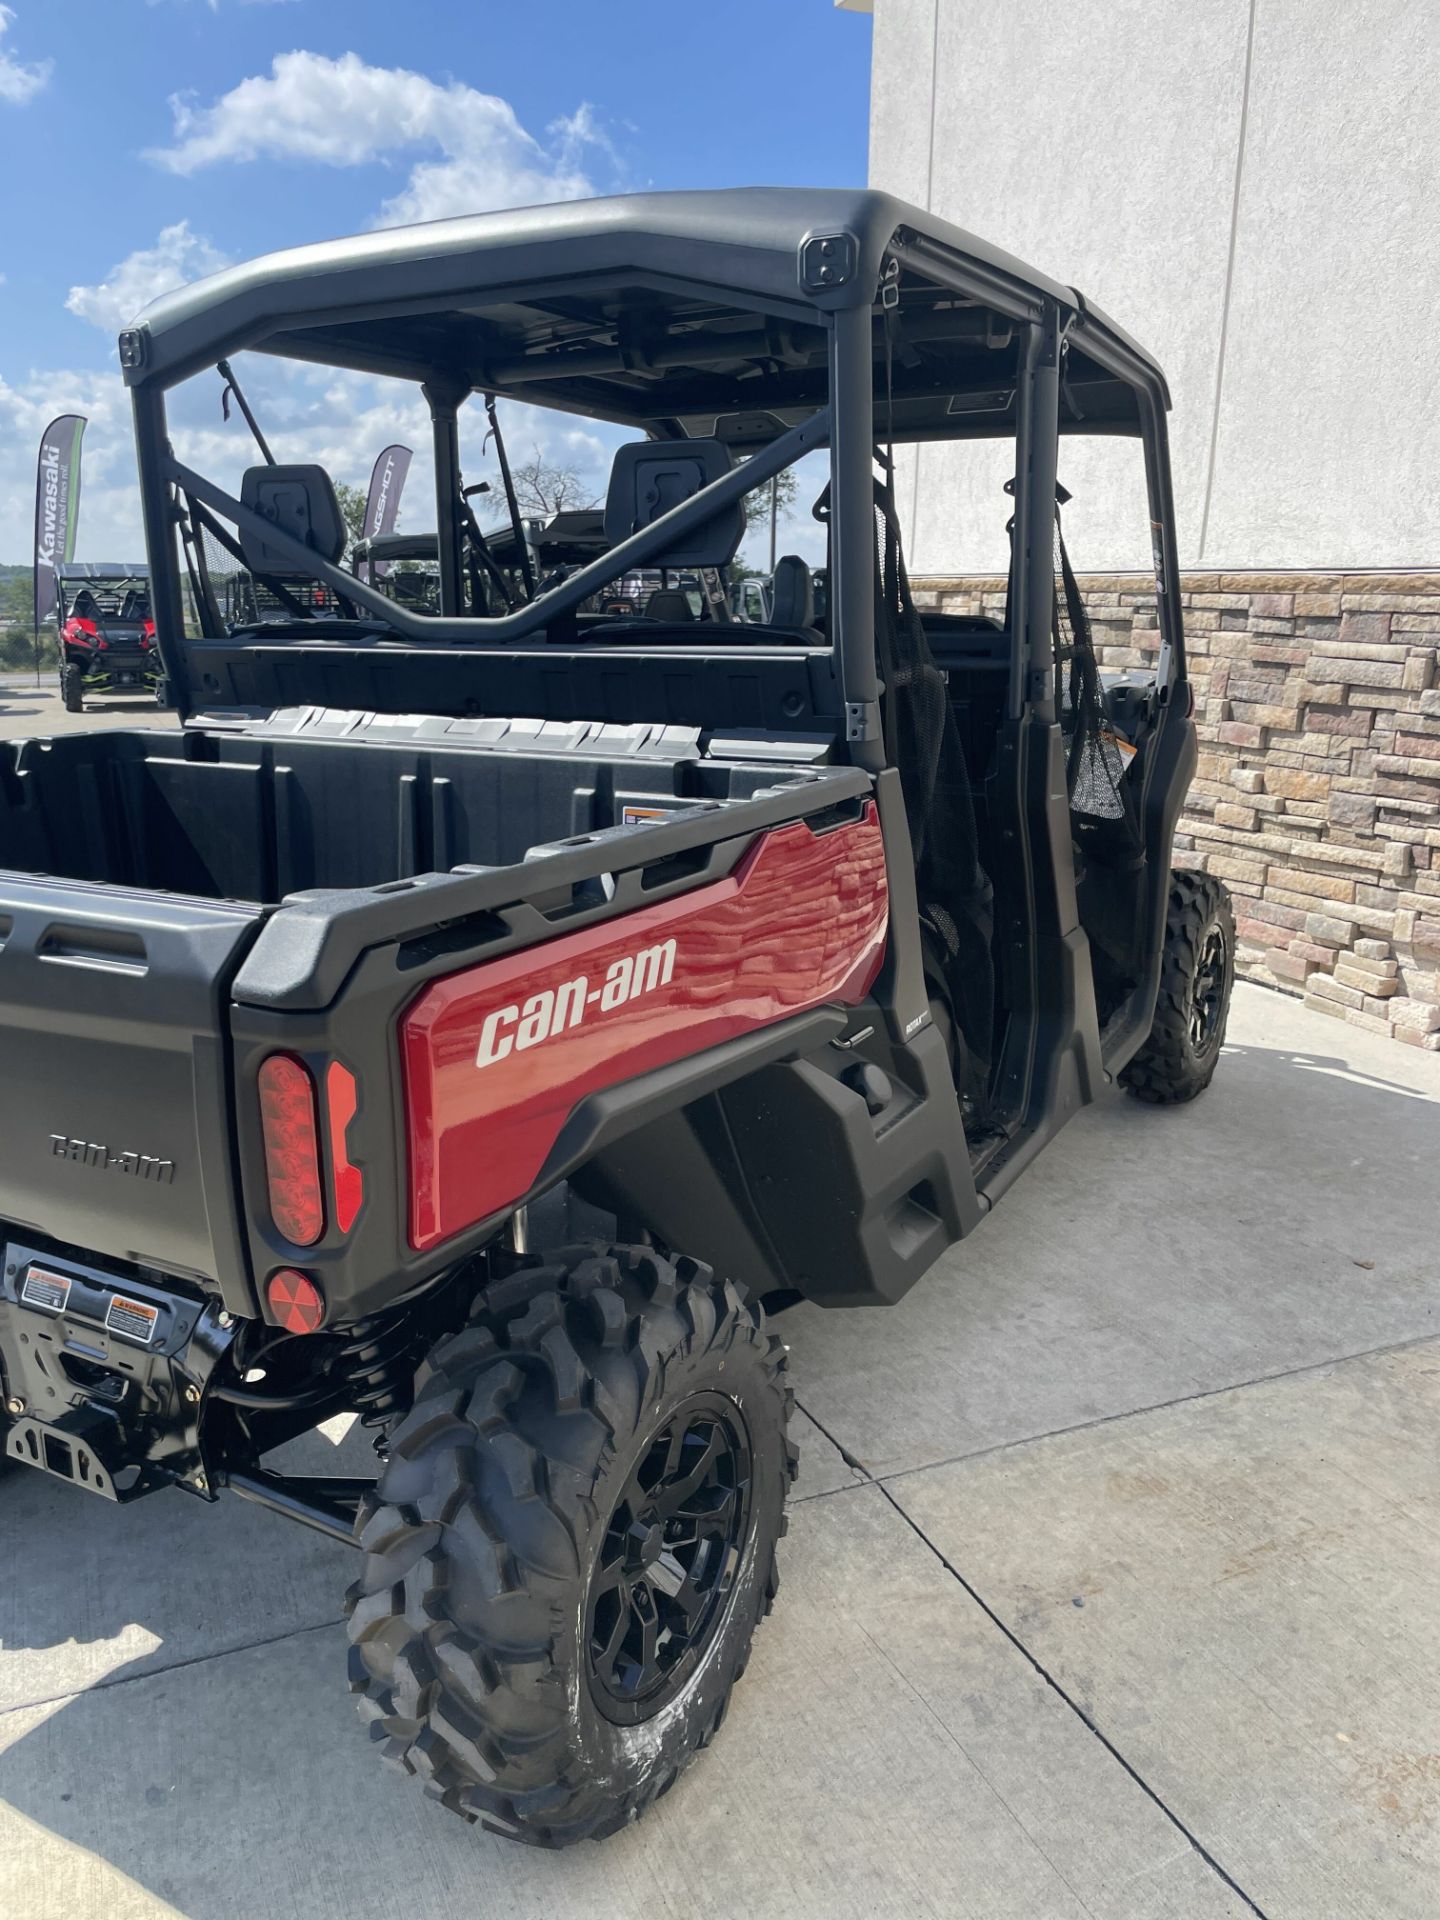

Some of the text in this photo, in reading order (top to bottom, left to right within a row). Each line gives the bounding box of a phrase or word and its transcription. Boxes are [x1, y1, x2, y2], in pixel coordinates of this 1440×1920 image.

[38, 445, 60, 567] Kawasaki
[60, 481, 68, 503] times
[372, 455, 395, 537] NGSHOT
[56, 525, 66, 539] the
[58, 503, 67, 526] good
[55, 540, 65, 554] Let
[475, 938, 677, 1069] can-am
[49, 1134, 175, 1184] can-am
